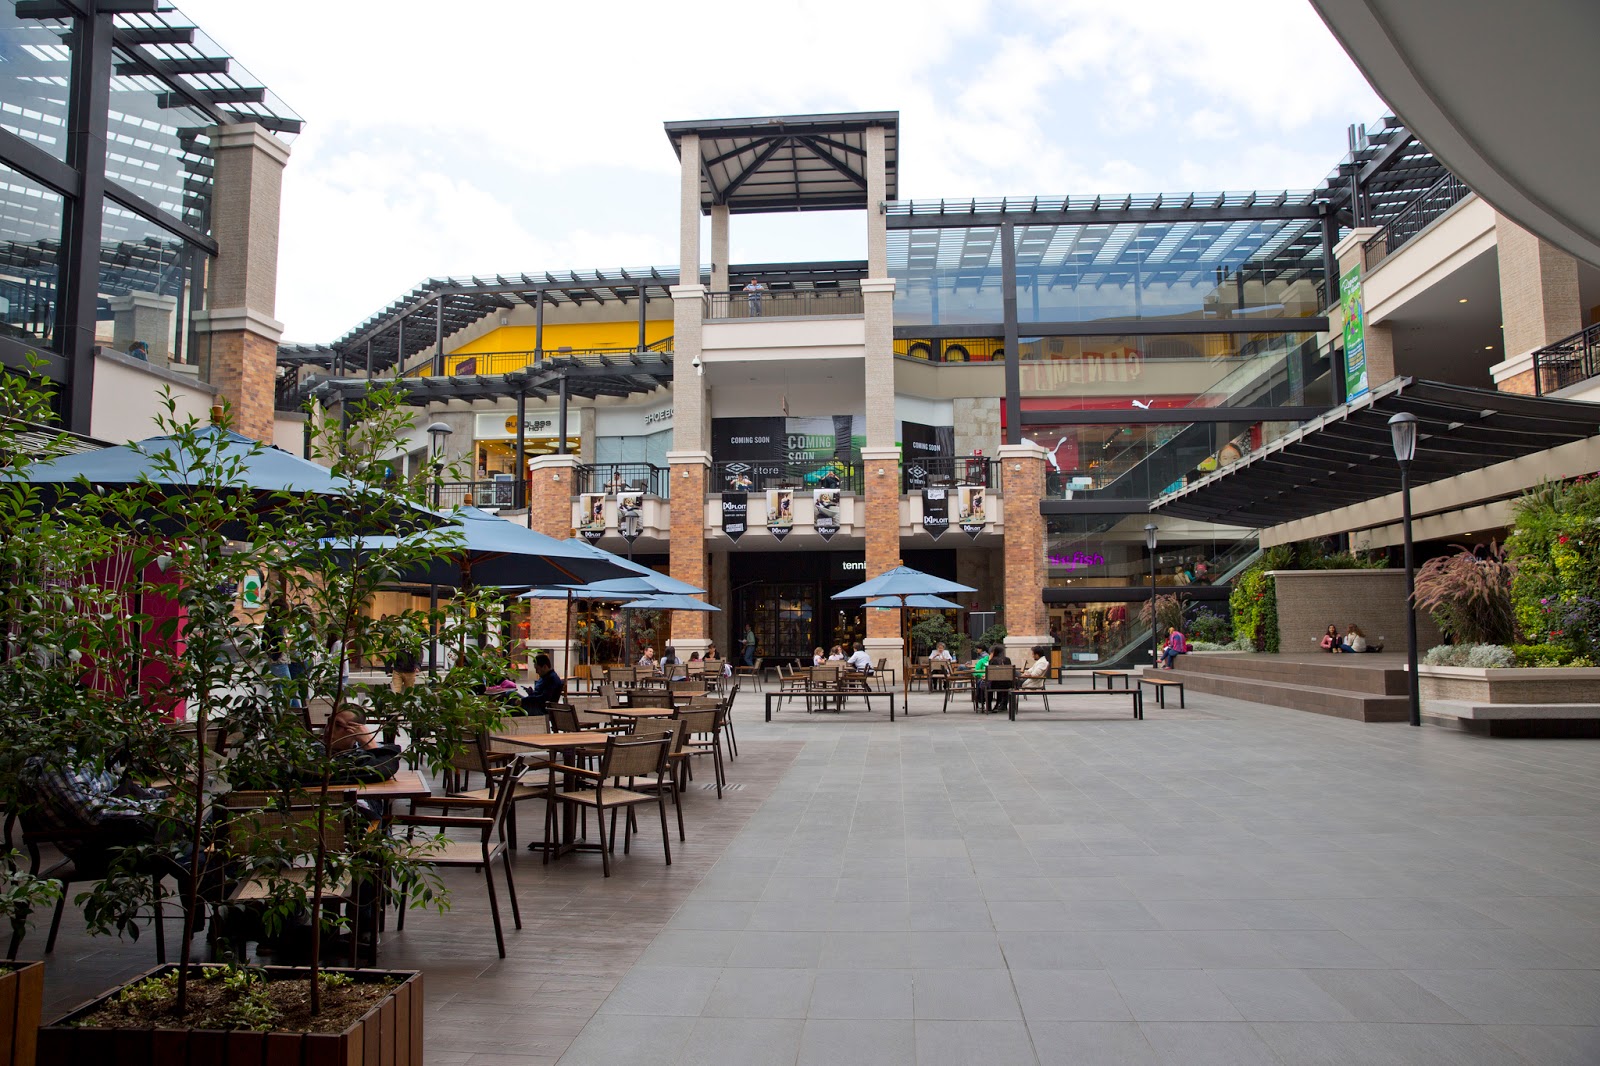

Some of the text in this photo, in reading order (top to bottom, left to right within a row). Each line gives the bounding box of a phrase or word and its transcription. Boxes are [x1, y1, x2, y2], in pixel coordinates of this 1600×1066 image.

[787, 435, 831, 449] COMING
[912, 441, 941, 452] COMING SOON
[788, 452, 815, 465] SOON
[753, 466, 779, 474] store
